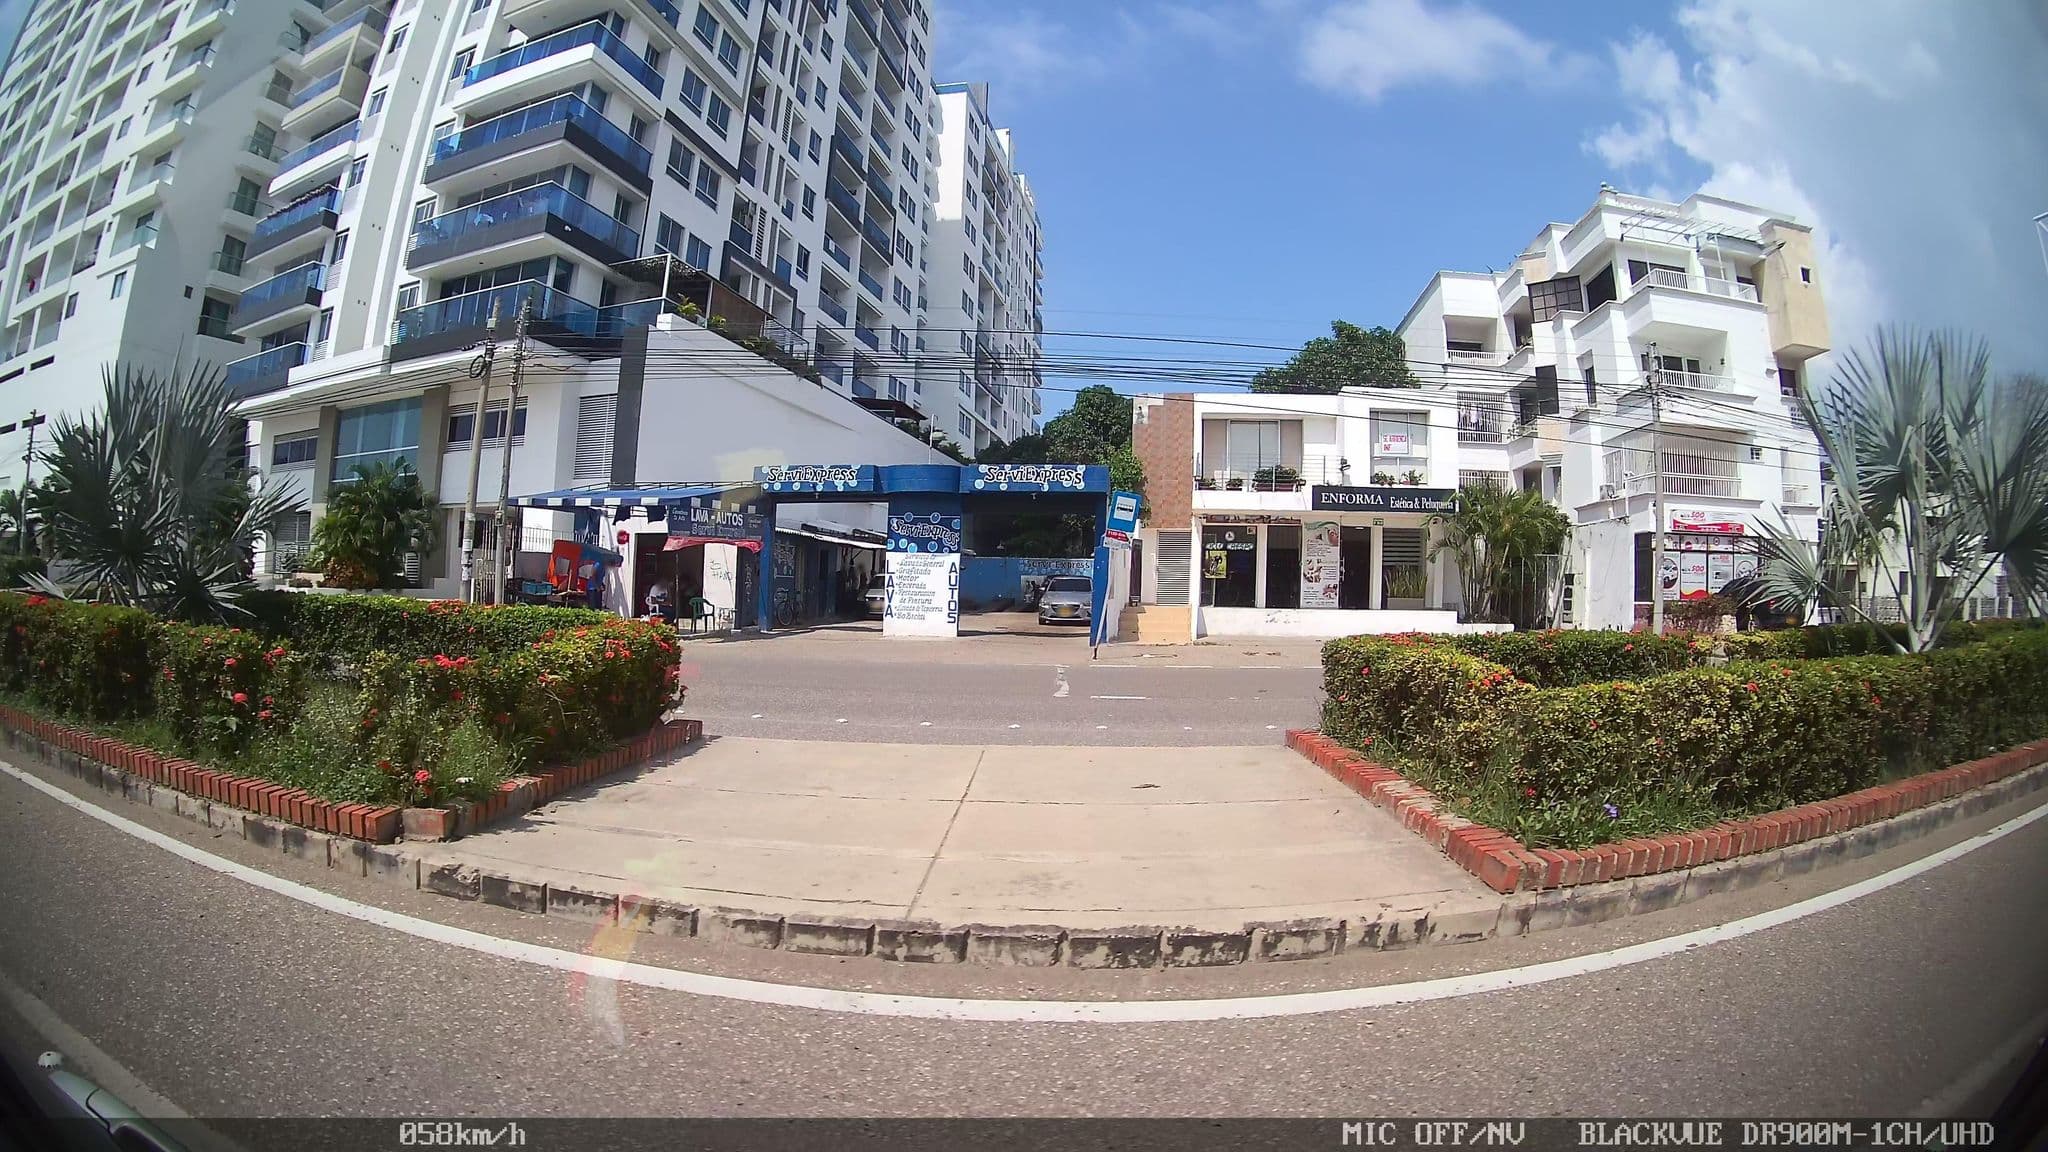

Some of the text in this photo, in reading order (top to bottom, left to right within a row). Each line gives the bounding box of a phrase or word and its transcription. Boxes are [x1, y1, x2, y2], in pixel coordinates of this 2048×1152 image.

[767, 465, 856, 484] ServiExpress
[985, 465, 1083, 486] ServiExpress
[1321, 492, 1384, 505] ENFORMA
[1414, 497, 1420, 509] &
[691, 508, 709, 523] LAVA
[716, 512, 744, 526] AUTOS
[885, 560, 896, 619] LAVA
[947, 562, 958, 624] AUTOS
